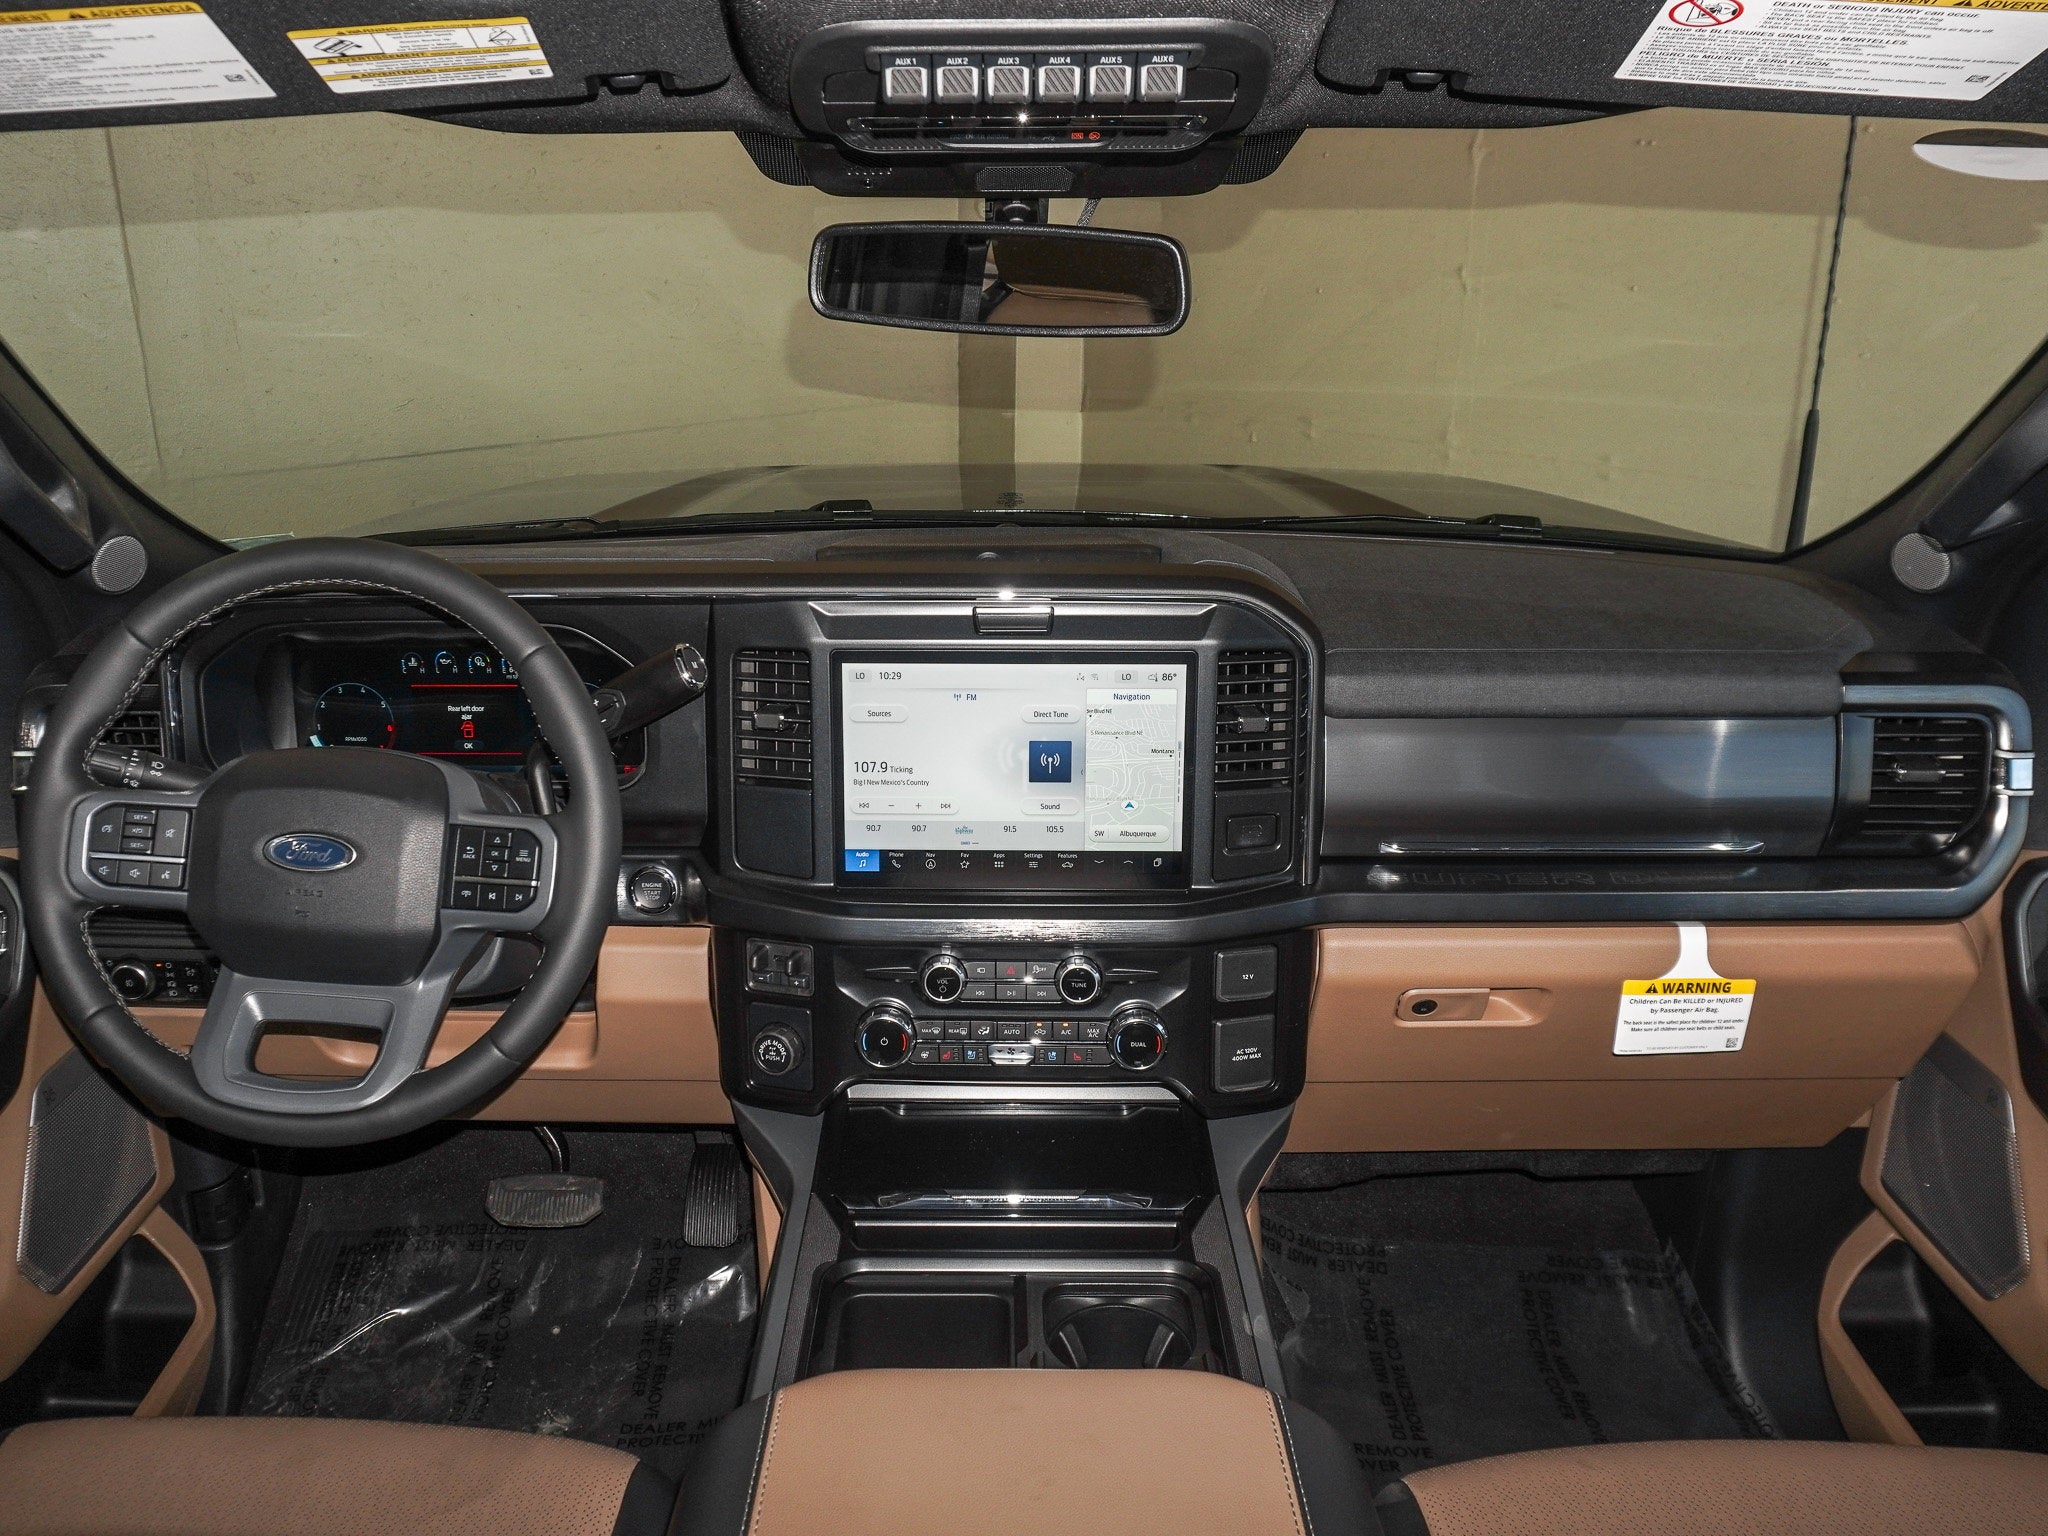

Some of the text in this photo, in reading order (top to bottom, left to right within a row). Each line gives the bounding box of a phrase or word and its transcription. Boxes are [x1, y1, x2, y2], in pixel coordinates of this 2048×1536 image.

[90, 5, 195, 19] ADVERTENCIA
[1708, 28, 1776, 37] BLESSURES
[1775, 32, 1824, 40] GRAVES
[879, 672, 902, 680] 10:29
[1162, 673, 1178, 681] 86°
[1114, 693, 1151, 701] Navigation
[854, 762, 914, 774] 107.9 Ticking
[854, 779, 863, 787] Big
[1120, 830, 1157, 838] Albuquerque
[1663, 982, 1732, 994] WARNING
[1660, 1007, 1693, 1015] Passenger
[759, 1040, 787, 1056] DRIVE MODE
[620, 1422, 688, 1435] DEALER
[1353, 1442, 1434, 1459] REMOVE
